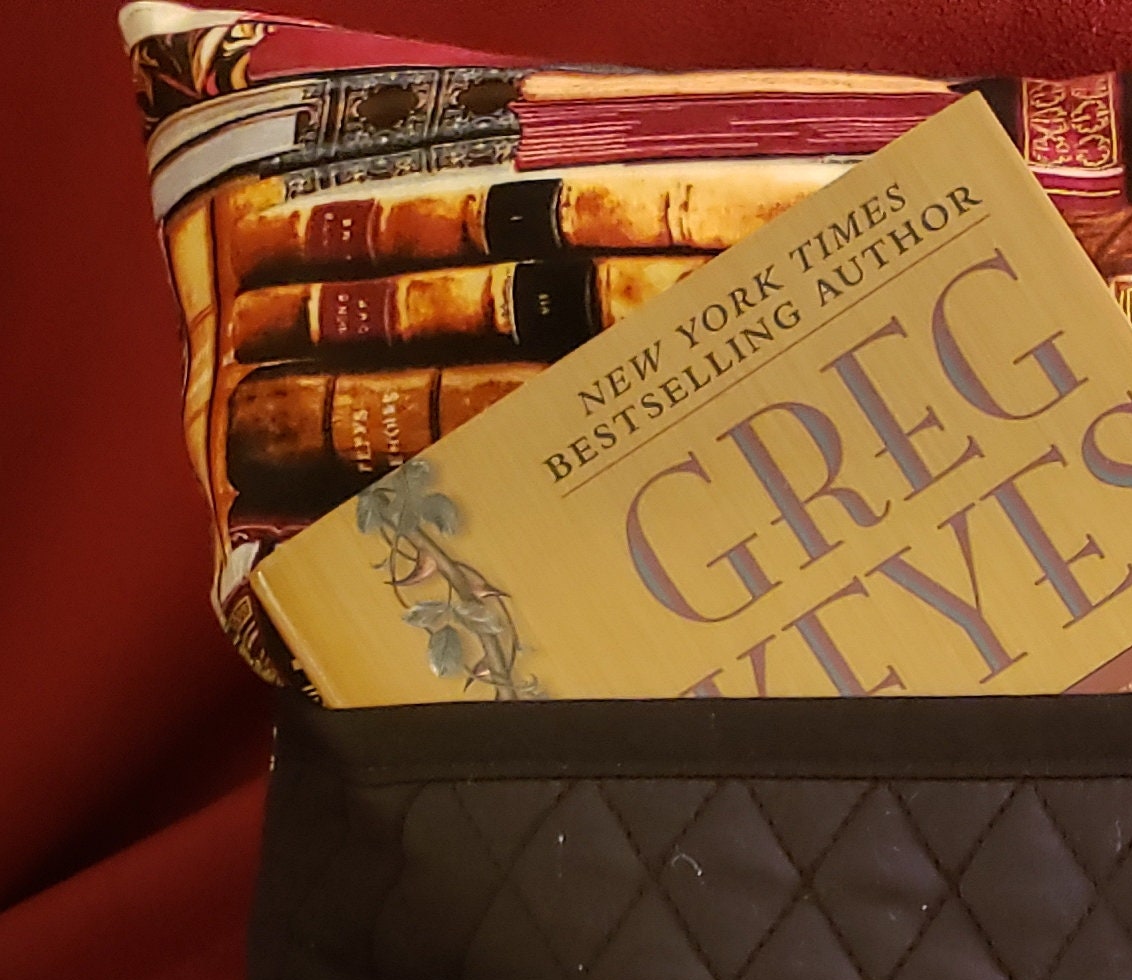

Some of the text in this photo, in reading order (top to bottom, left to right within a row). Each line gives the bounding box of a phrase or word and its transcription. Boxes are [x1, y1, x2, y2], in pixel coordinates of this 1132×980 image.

[542, 301, 801, 483] BESTSELLING
[815, 186, 983, 307] AUTHOR
[577, 182, 907, 416] NEW YORK TIMES
[626, 248, 1089, 624] GREG
